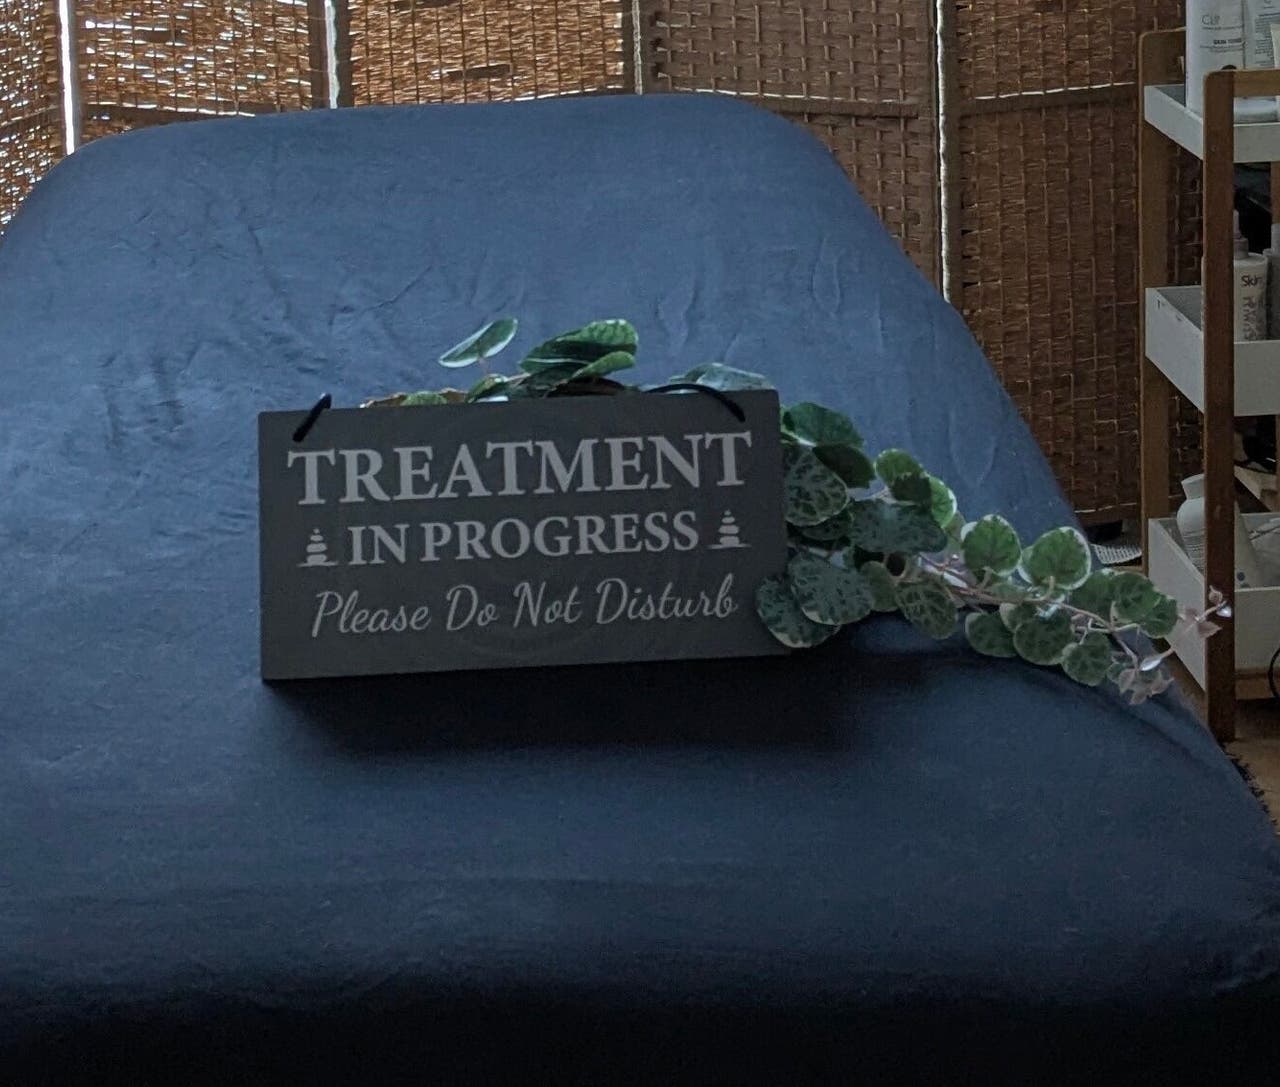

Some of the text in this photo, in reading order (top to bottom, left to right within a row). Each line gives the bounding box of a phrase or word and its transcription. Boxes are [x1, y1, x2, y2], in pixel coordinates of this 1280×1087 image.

[287, 431, 753, 505] TREATMENT
[347, 510, 700, 567] IN PROGRESS
[311, 572, 739, 638] Please Do Not Disturb
